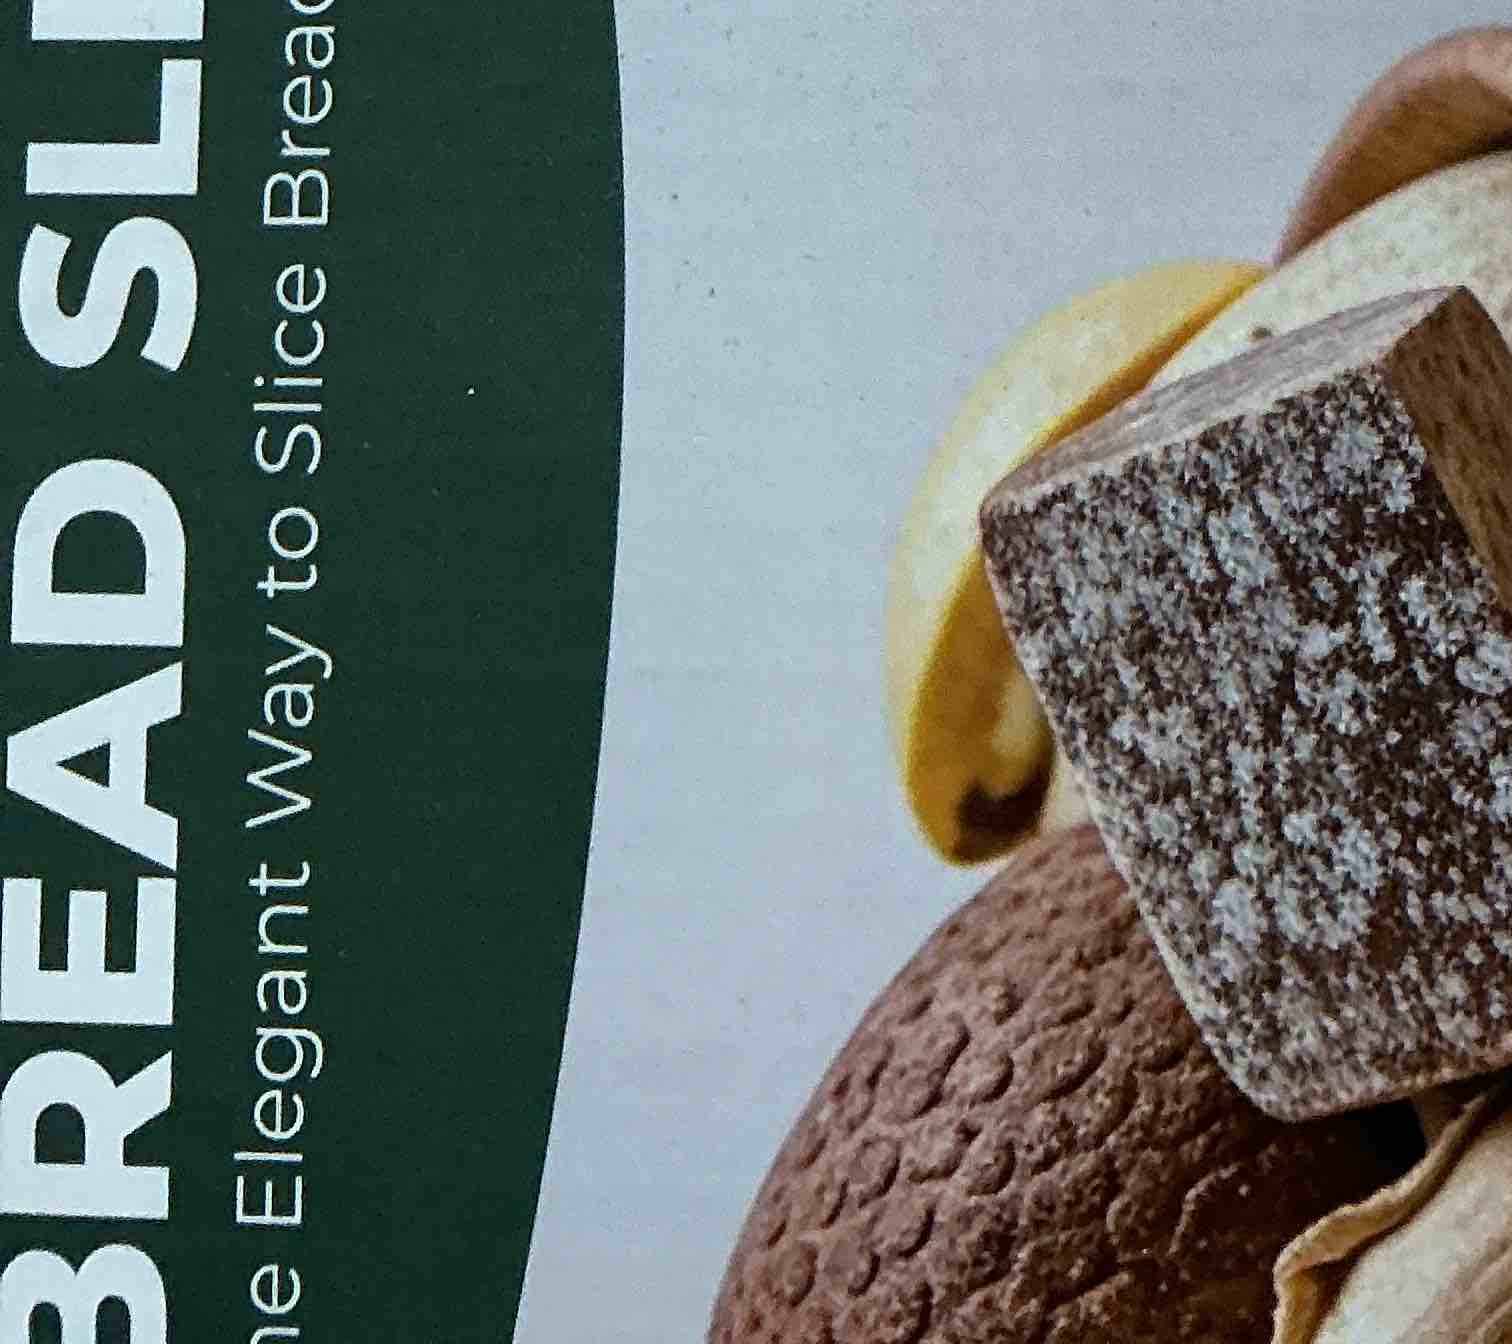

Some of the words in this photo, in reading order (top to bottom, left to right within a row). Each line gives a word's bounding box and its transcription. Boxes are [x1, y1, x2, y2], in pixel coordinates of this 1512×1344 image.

[253, 263, 327, 475] Slice
[256, 506, 319, 598] to
[245, 623, 333, 828] Way
[0, 458, 187, 1344] BREAD
[233, 861, 324, 1226] Elegant
